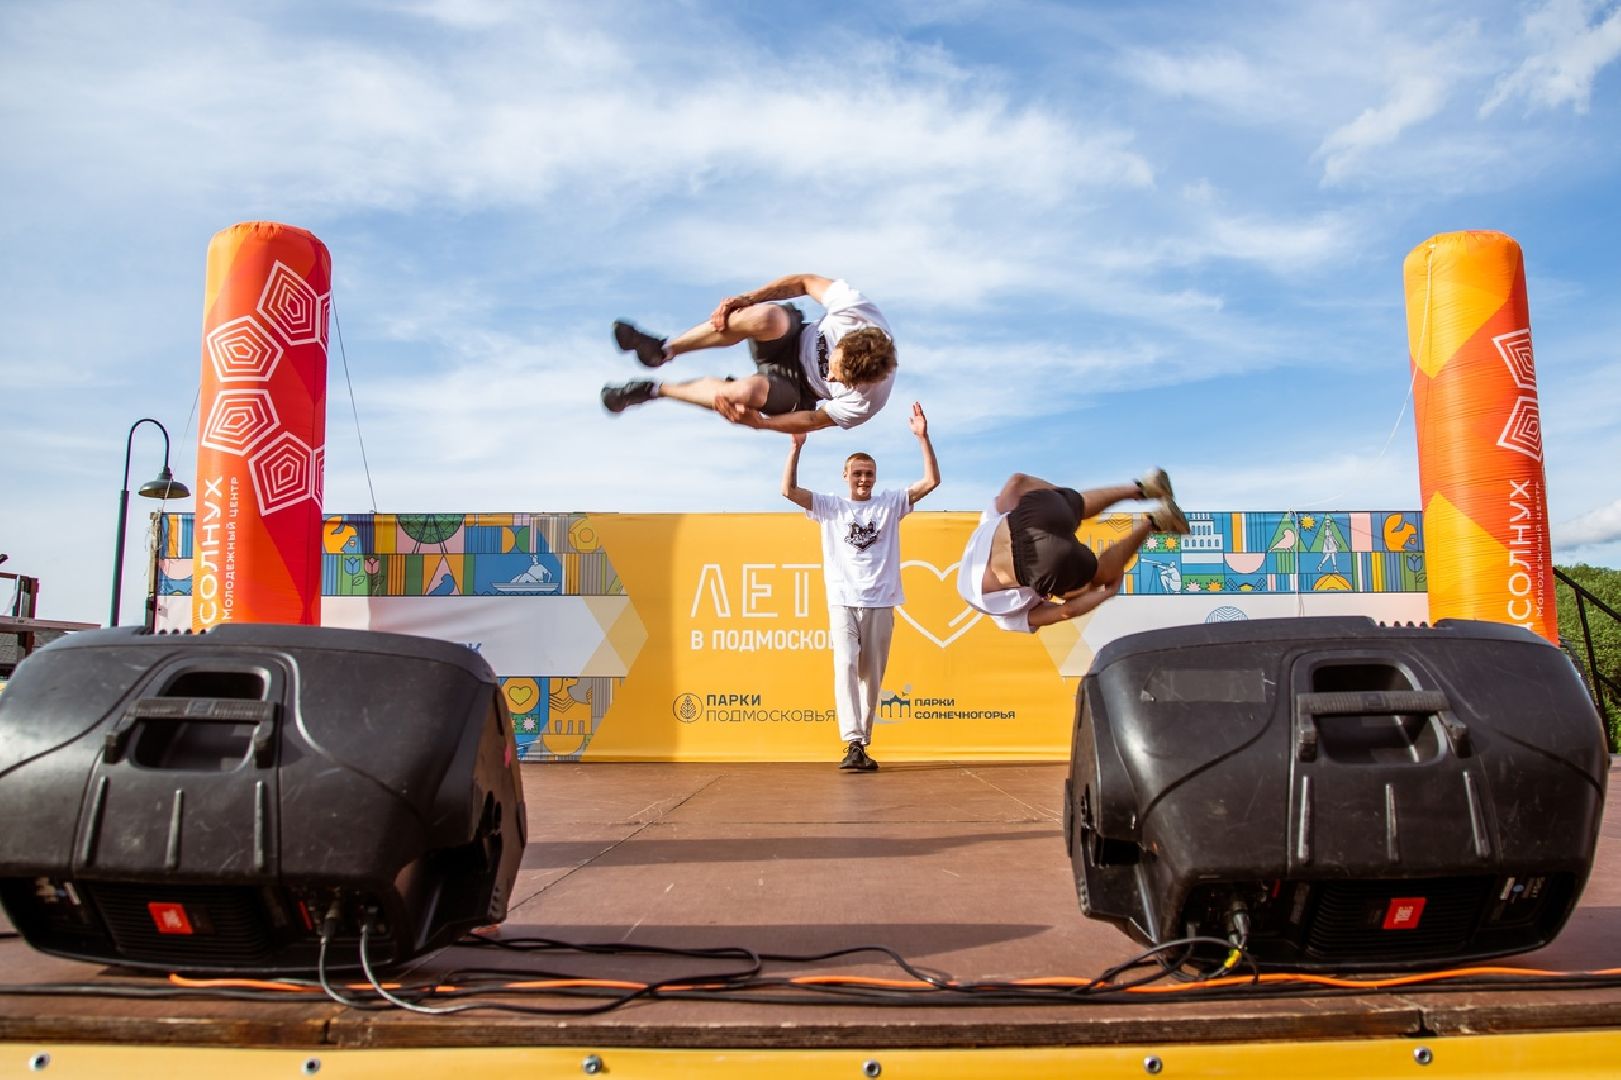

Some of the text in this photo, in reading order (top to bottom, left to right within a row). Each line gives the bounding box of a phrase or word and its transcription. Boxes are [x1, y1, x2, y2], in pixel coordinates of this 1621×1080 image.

[229, 476, 240, 518] ЦЕНТР
[199, 476, 223, 627] СОЛНУХ
[690, 563, 822, 618] ЛЕТ
[690, 629, 704, 650] В
[706, 694, 762, 706] ПАРКИ
[914, 698, 955, 707] ПАРКИ
[706, 709, 836, 722] ПОДМОСКОВЬЯ
[914, 711, 1016, 720] СОЛНЕЧНОГОРЬЯ
